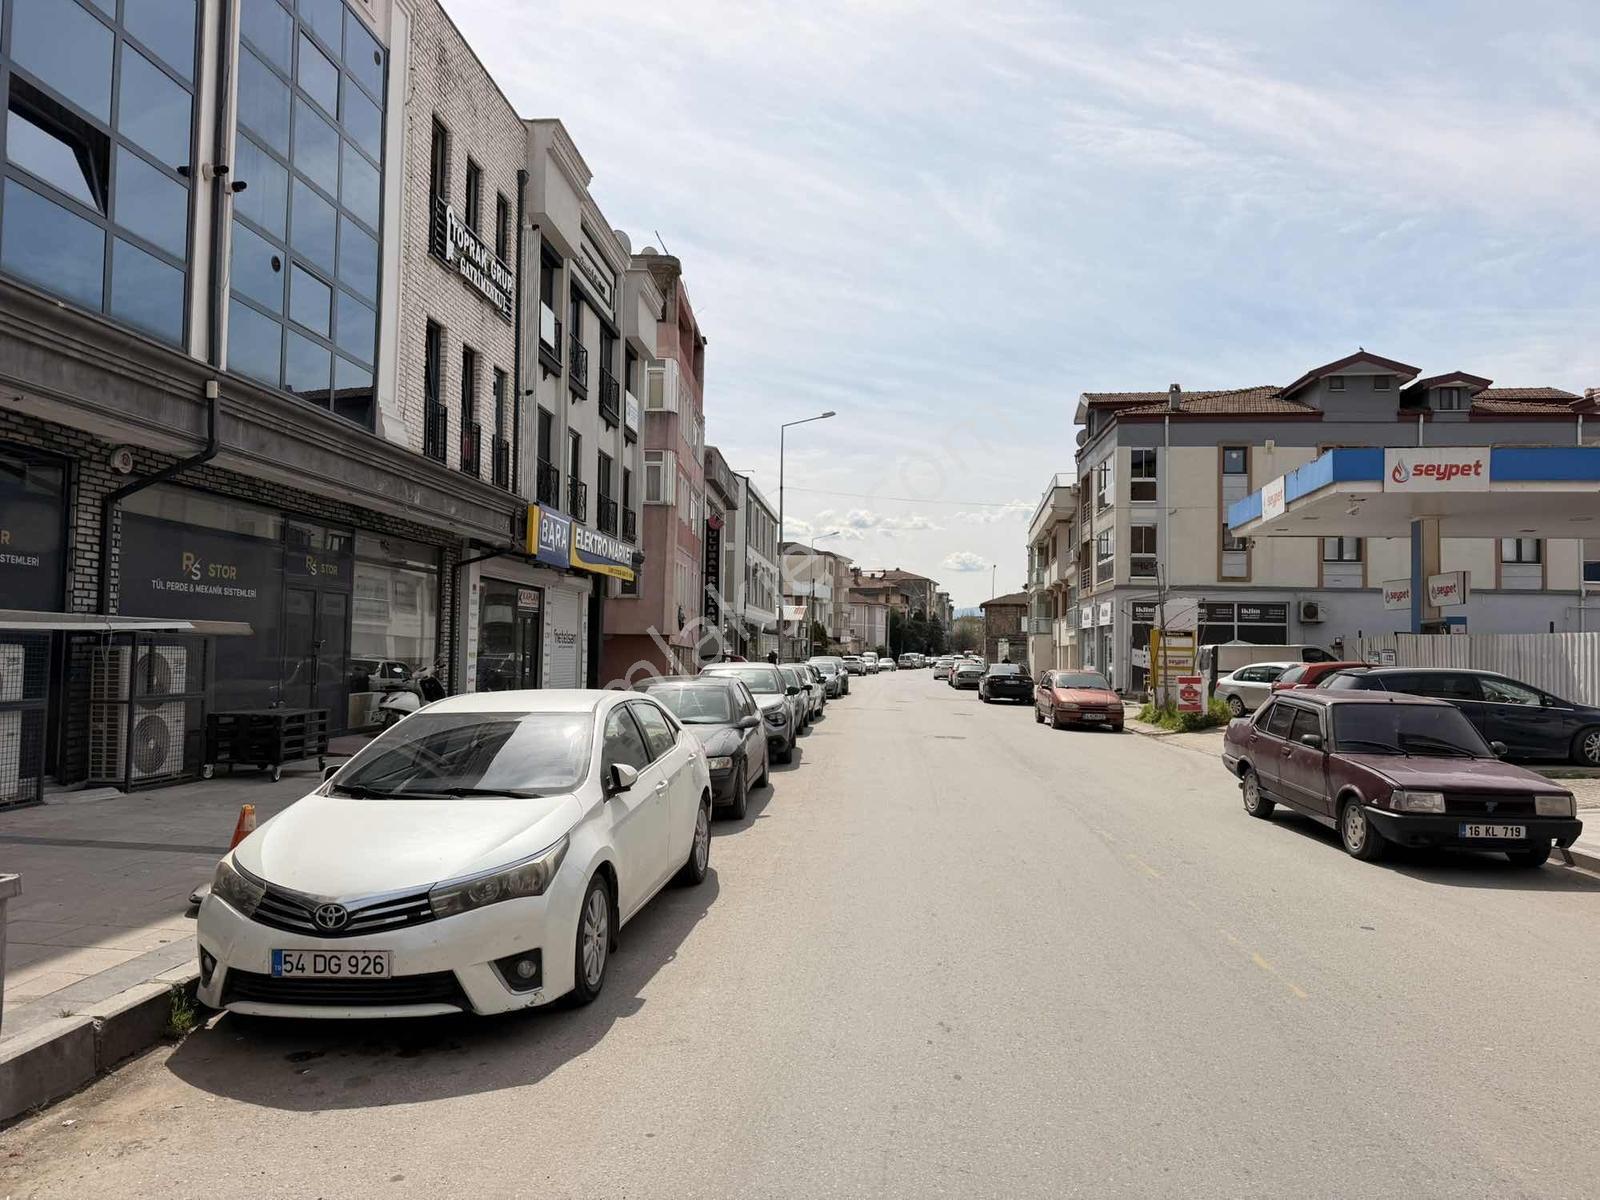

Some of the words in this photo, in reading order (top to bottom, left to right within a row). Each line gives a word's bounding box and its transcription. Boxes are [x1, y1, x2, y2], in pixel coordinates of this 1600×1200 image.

[453, 222, 488, 272] TOPRAK
[491, 260, 514, 293] GRUP
[1412, 459, 1483, 481] seypet
[541, 518, 567, 552] BARA
[575, 527, 607, 557] ELEKTRO
[608, 540, 633, 566] MARKET
[208, 563, 237, 579] STOR
[320, 564, 338, 576] STOR
[151, 579, 165, 590] TÜL
[166, 581, 188, 592] PERDE
[189, 584, 194, 592] &
[195, 584, 223, 596] MEKANİK
[223, 587, 257, 599] SİSTEMLERİ
[1390, 589, 1410, 602] seypet
[1436, 583, 1456, 597] seypet
[1469, 826, 1480, 837] 16
[1485, 826, 1498, 837] KL
[1503, 826, 1521, 838] 719
[283, 953, 306, 973] 54
[313, 954, 342, 974] DG
[348, 955, 384, 975] 926
